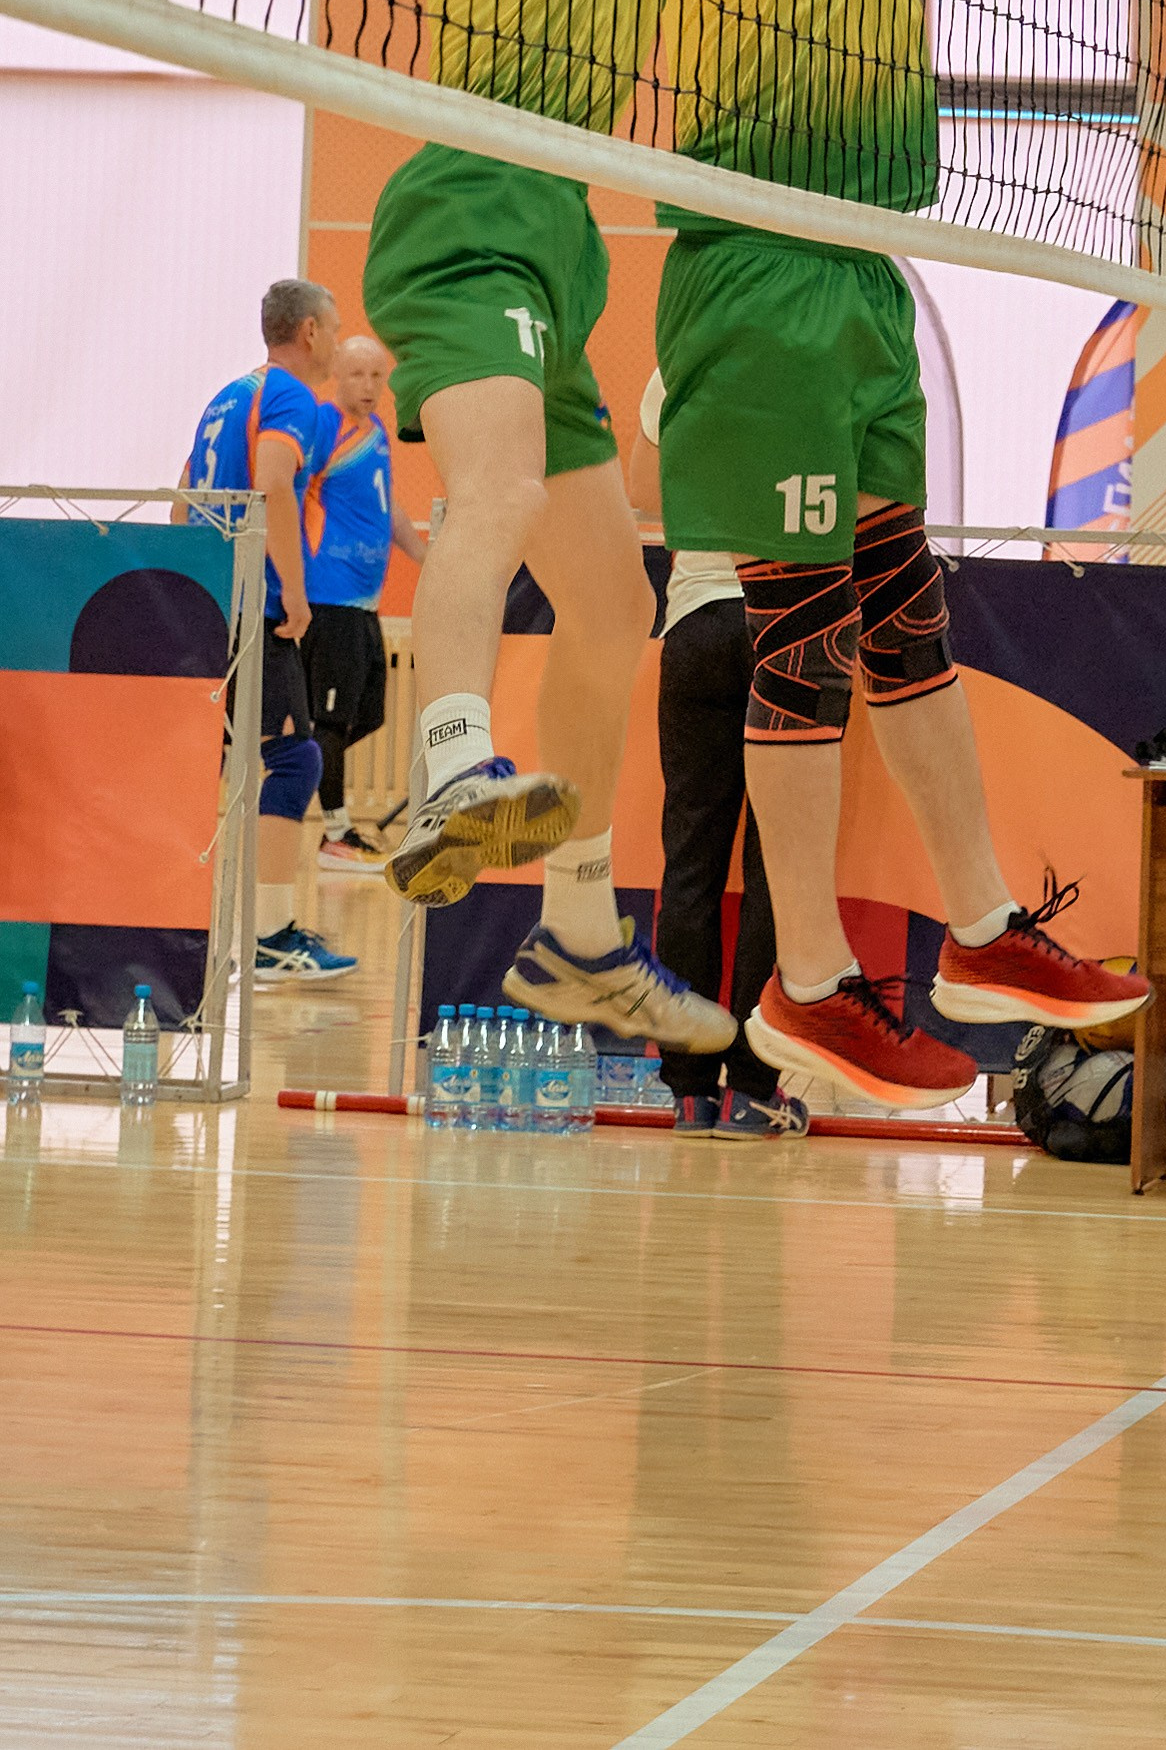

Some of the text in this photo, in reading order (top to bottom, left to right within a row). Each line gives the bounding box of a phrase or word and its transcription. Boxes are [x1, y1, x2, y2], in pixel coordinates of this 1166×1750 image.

[373, 468, 388, 514] 1
[775, 474, 837, 535] 15
[433, 722, 462, 741] TEAM
